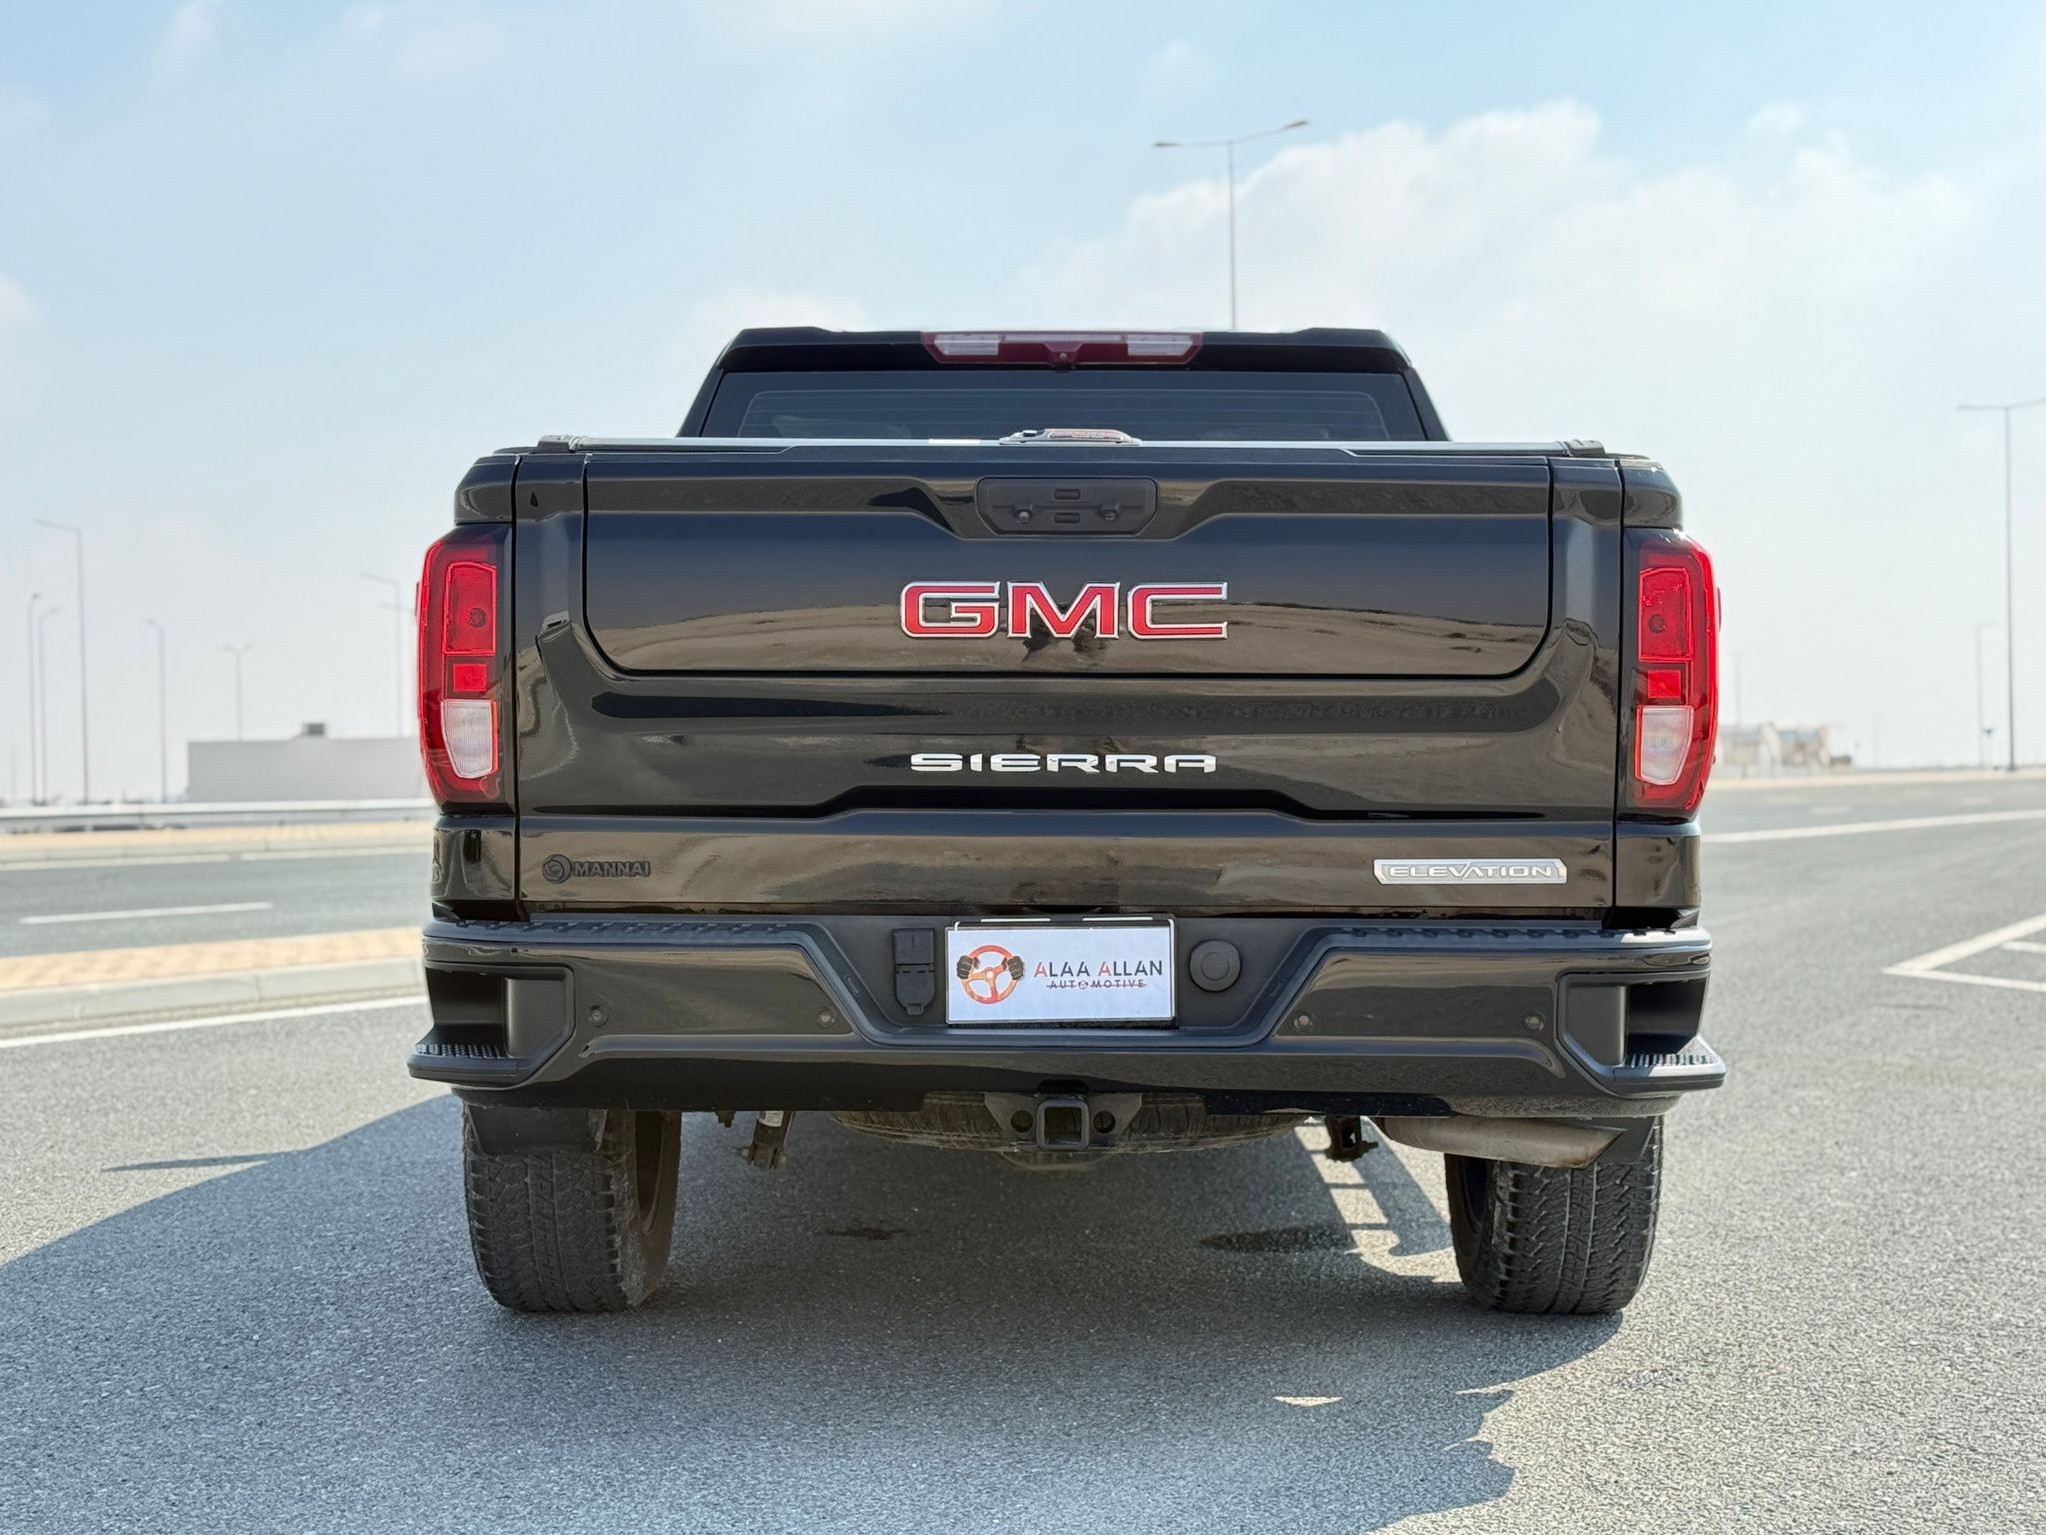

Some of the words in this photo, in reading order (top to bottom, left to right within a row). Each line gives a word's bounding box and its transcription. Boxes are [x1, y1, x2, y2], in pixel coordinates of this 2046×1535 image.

[901, 580, 1228, 640] GMC
[910, 753, 1216, 774] SIERRA
[574, 861, 652, 877] MANNAI
[1389, 865, 1552, 878] ELEVATION
[1034, 961, 1091, 977] ALAA
[1098, 959, 1163, 977] ALLAN
[1049, 979, 1145, 990] AUTOMOTIVE
